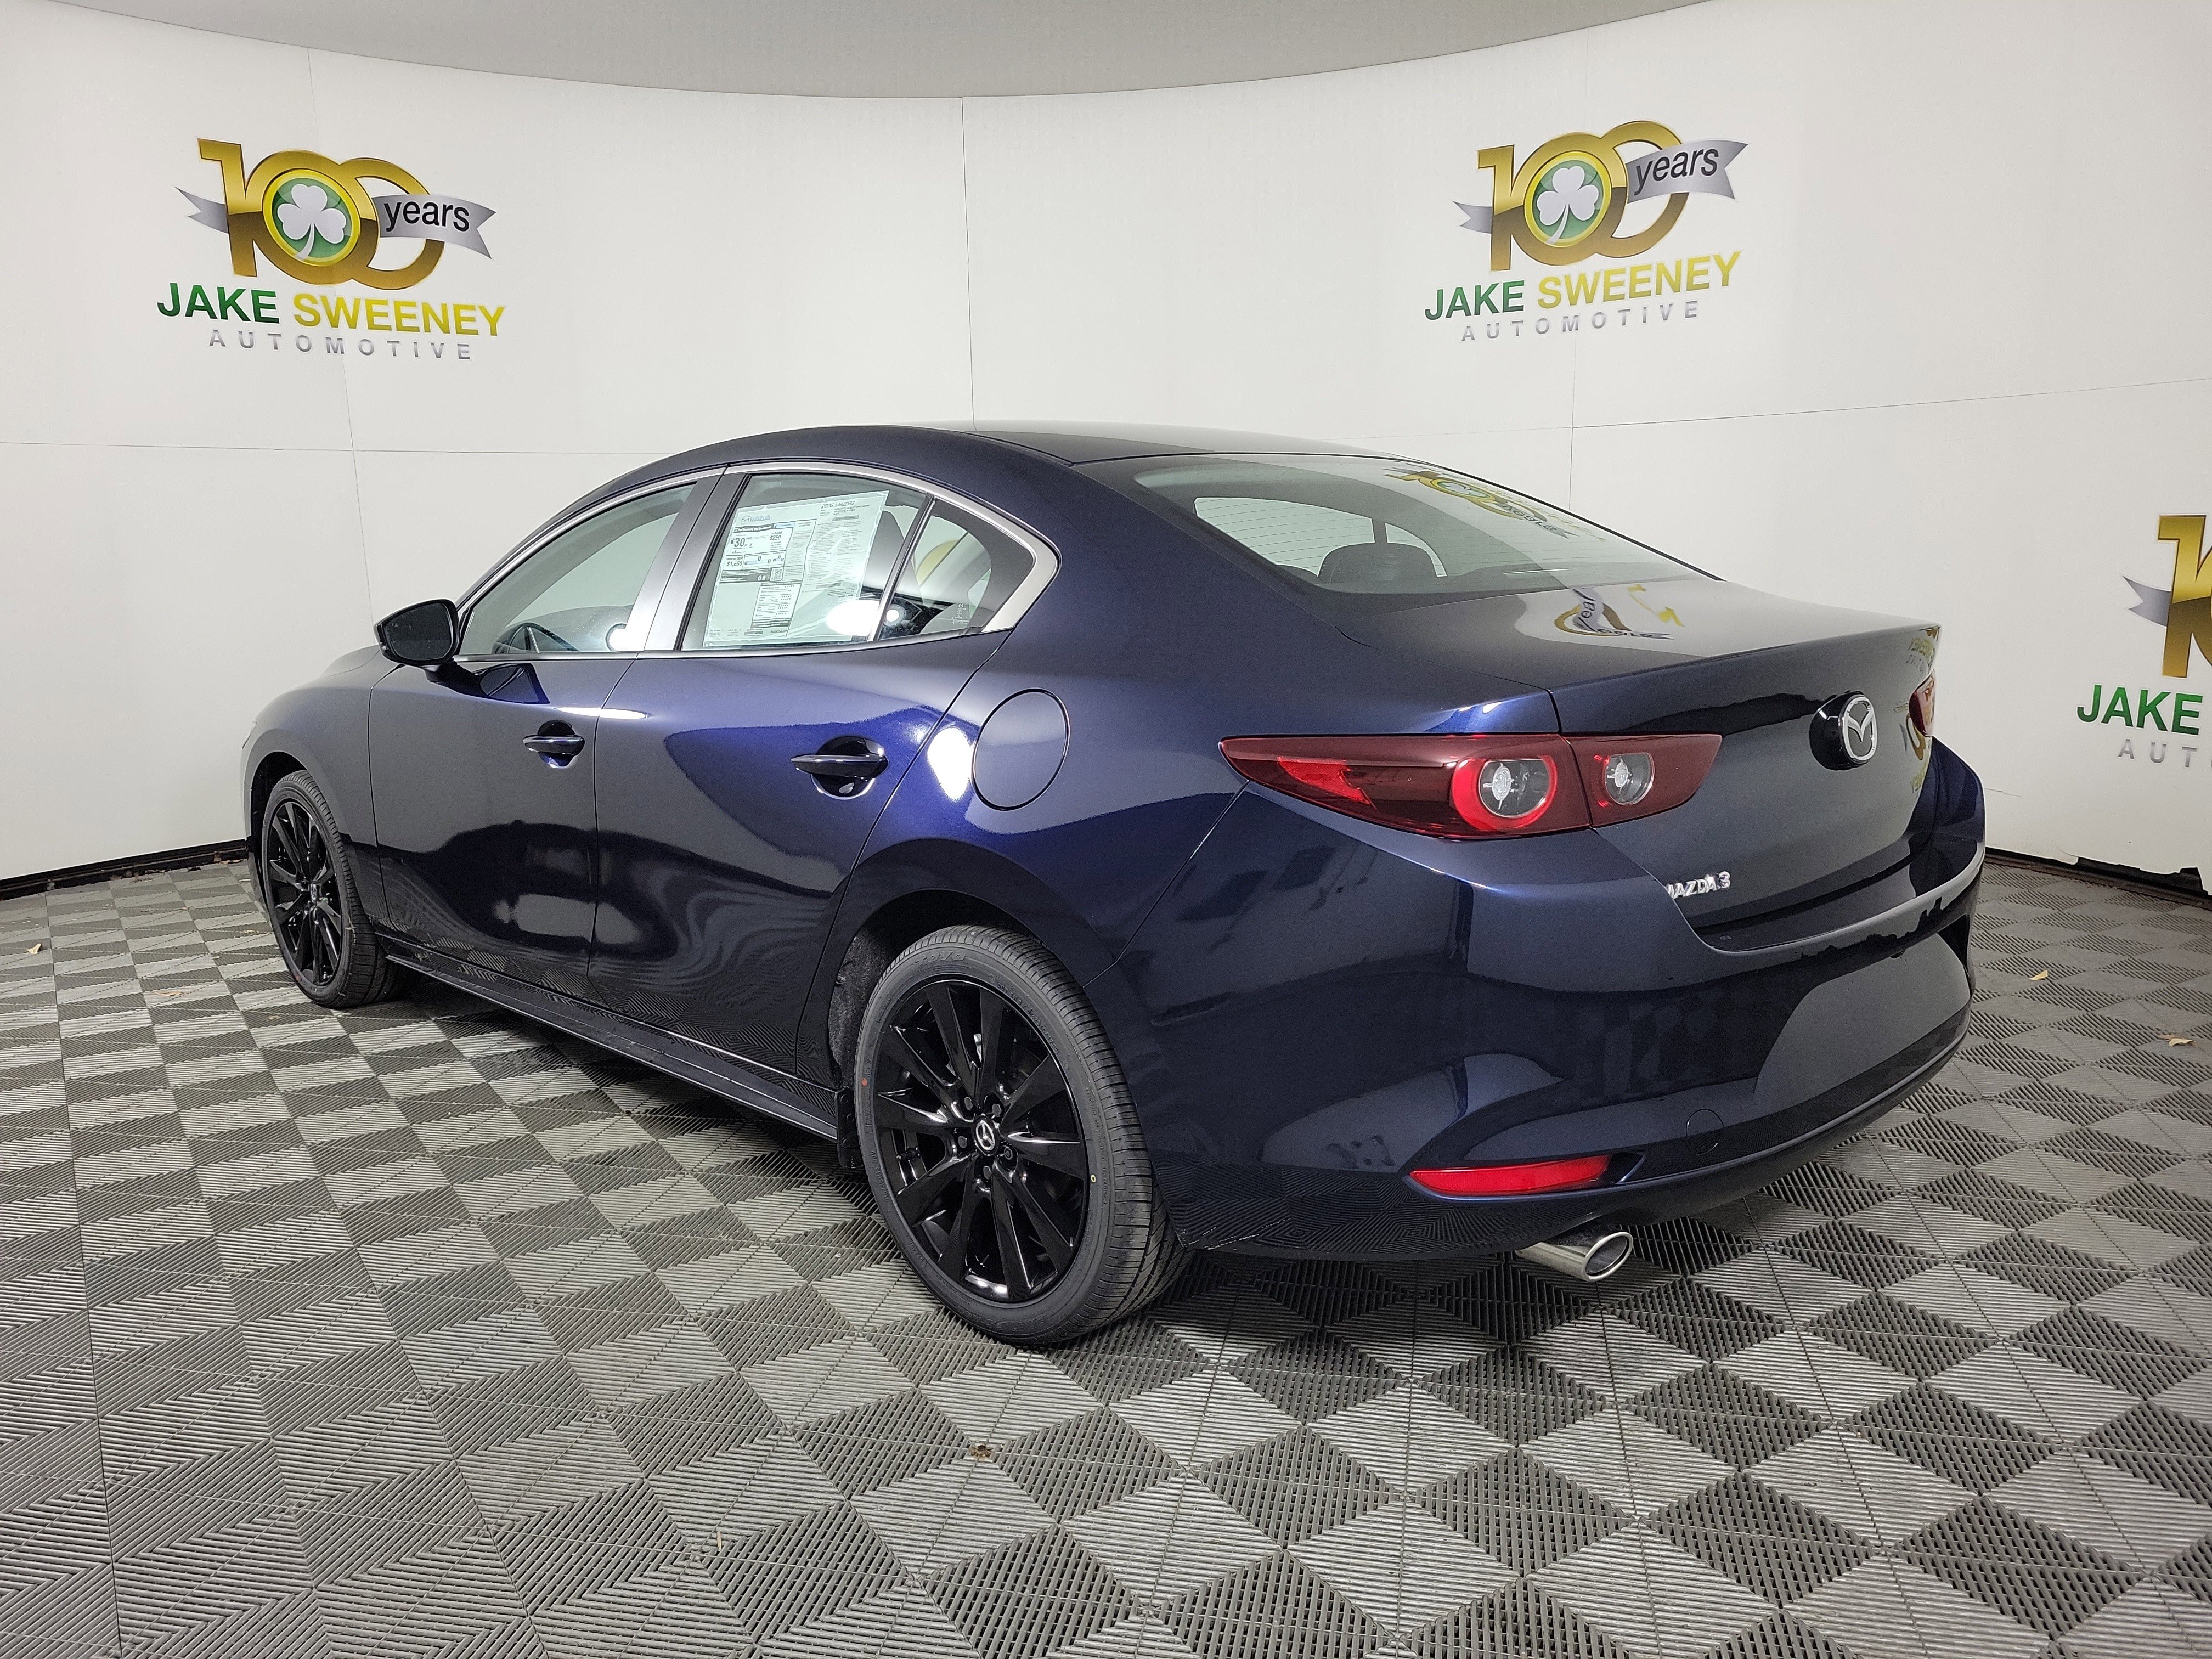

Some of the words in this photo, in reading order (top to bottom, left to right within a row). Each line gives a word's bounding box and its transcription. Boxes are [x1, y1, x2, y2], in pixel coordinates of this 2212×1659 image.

[1635, 148, 1719, 196] years
[383, 201, 470, 232] years
[1425, 280, 1525, 320] JAKE
[1537, 251, 1741, 309] SWEENEY
[157, 283, 280, 324] JAKE
[293, 292, 505, 337] SWEENEY
[1462, 300, 1699, 342] AUTOMOTIVE
[209, 329, 471, 360] AUTOMOTIVE
[734, 538, 745, 547] 30
[2077, 684, 2203, 735] JAKE
[2118, 738, 2212, 767] AUT
[915, 951, 966, 966] TOYO
